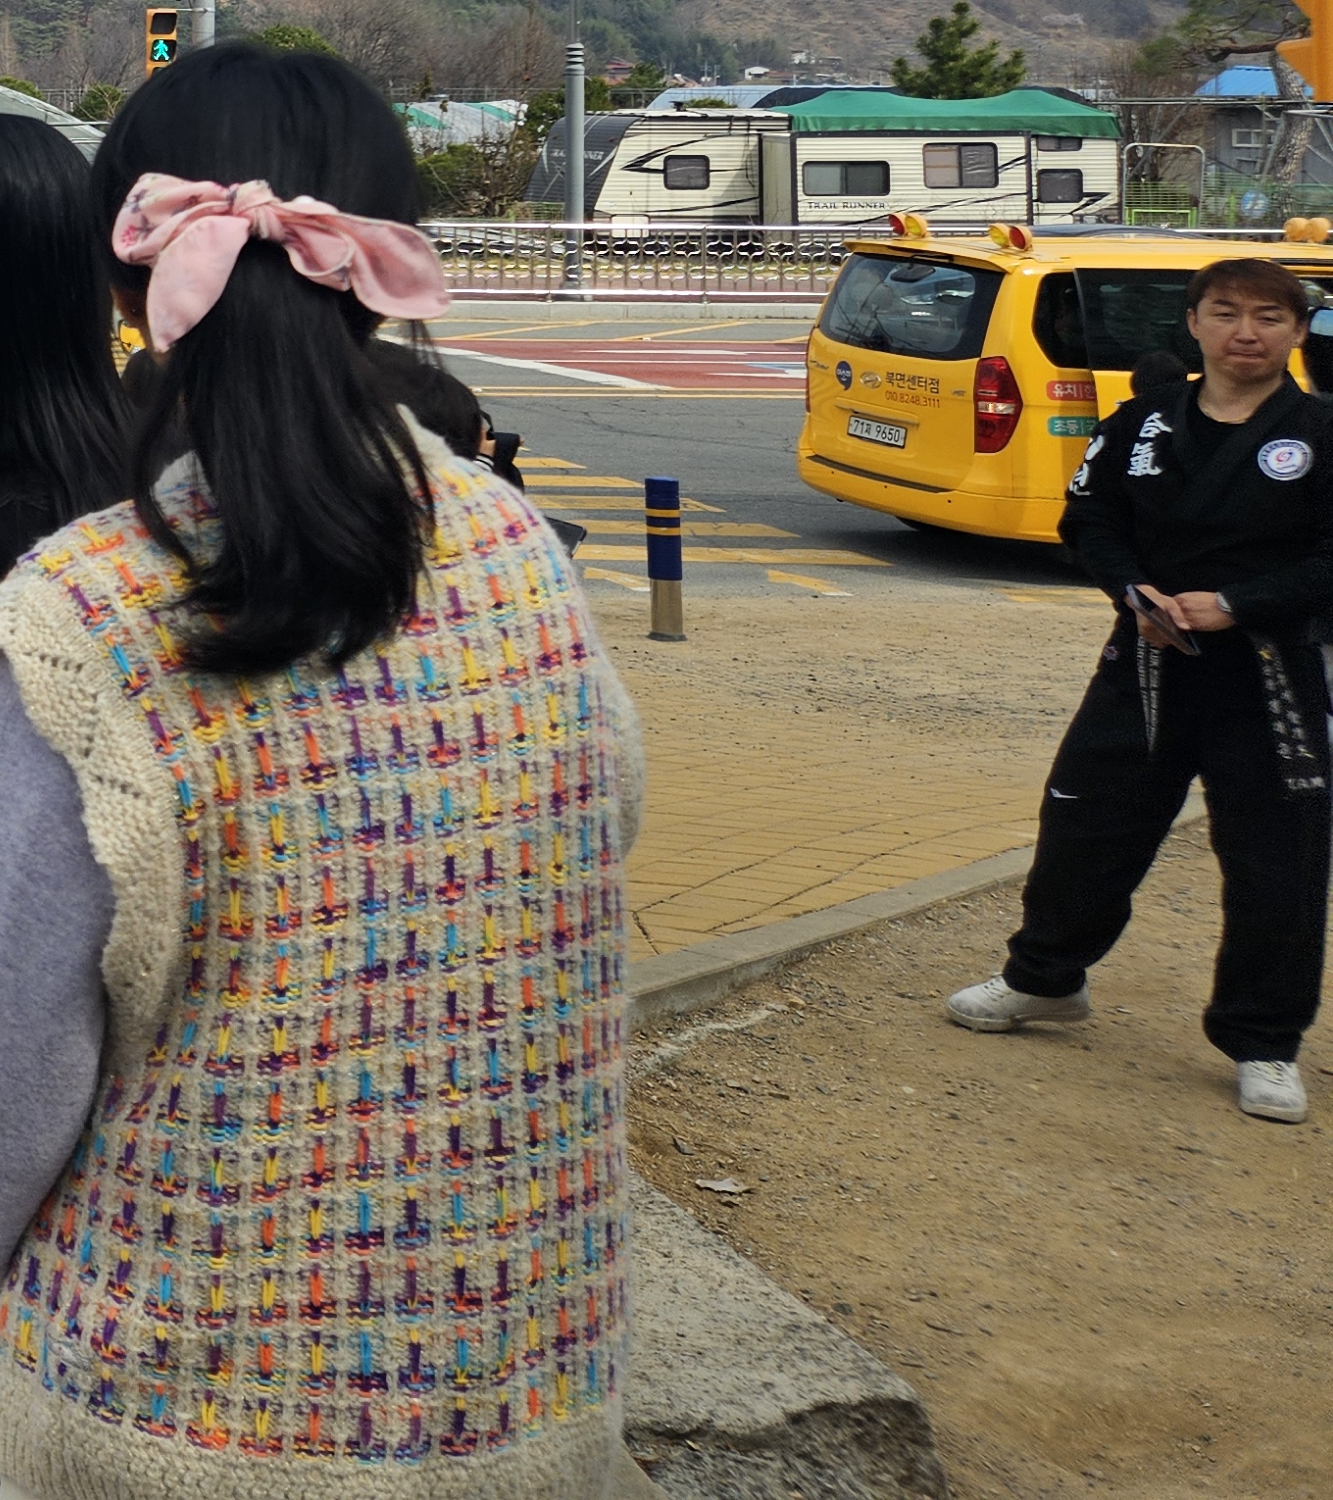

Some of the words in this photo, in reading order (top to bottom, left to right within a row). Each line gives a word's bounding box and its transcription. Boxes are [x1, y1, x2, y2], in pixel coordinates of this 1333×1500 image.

[807, 201, 838, 209] TRAIL
[841, 201, 886, 210] RUNNER
[885, 371, 940, 395] 북면센터점
[1052, 383, 1077, 398] 유치
[875, 424, 901, 443] 9650
[1053, 419, 1079, 435] 초등
